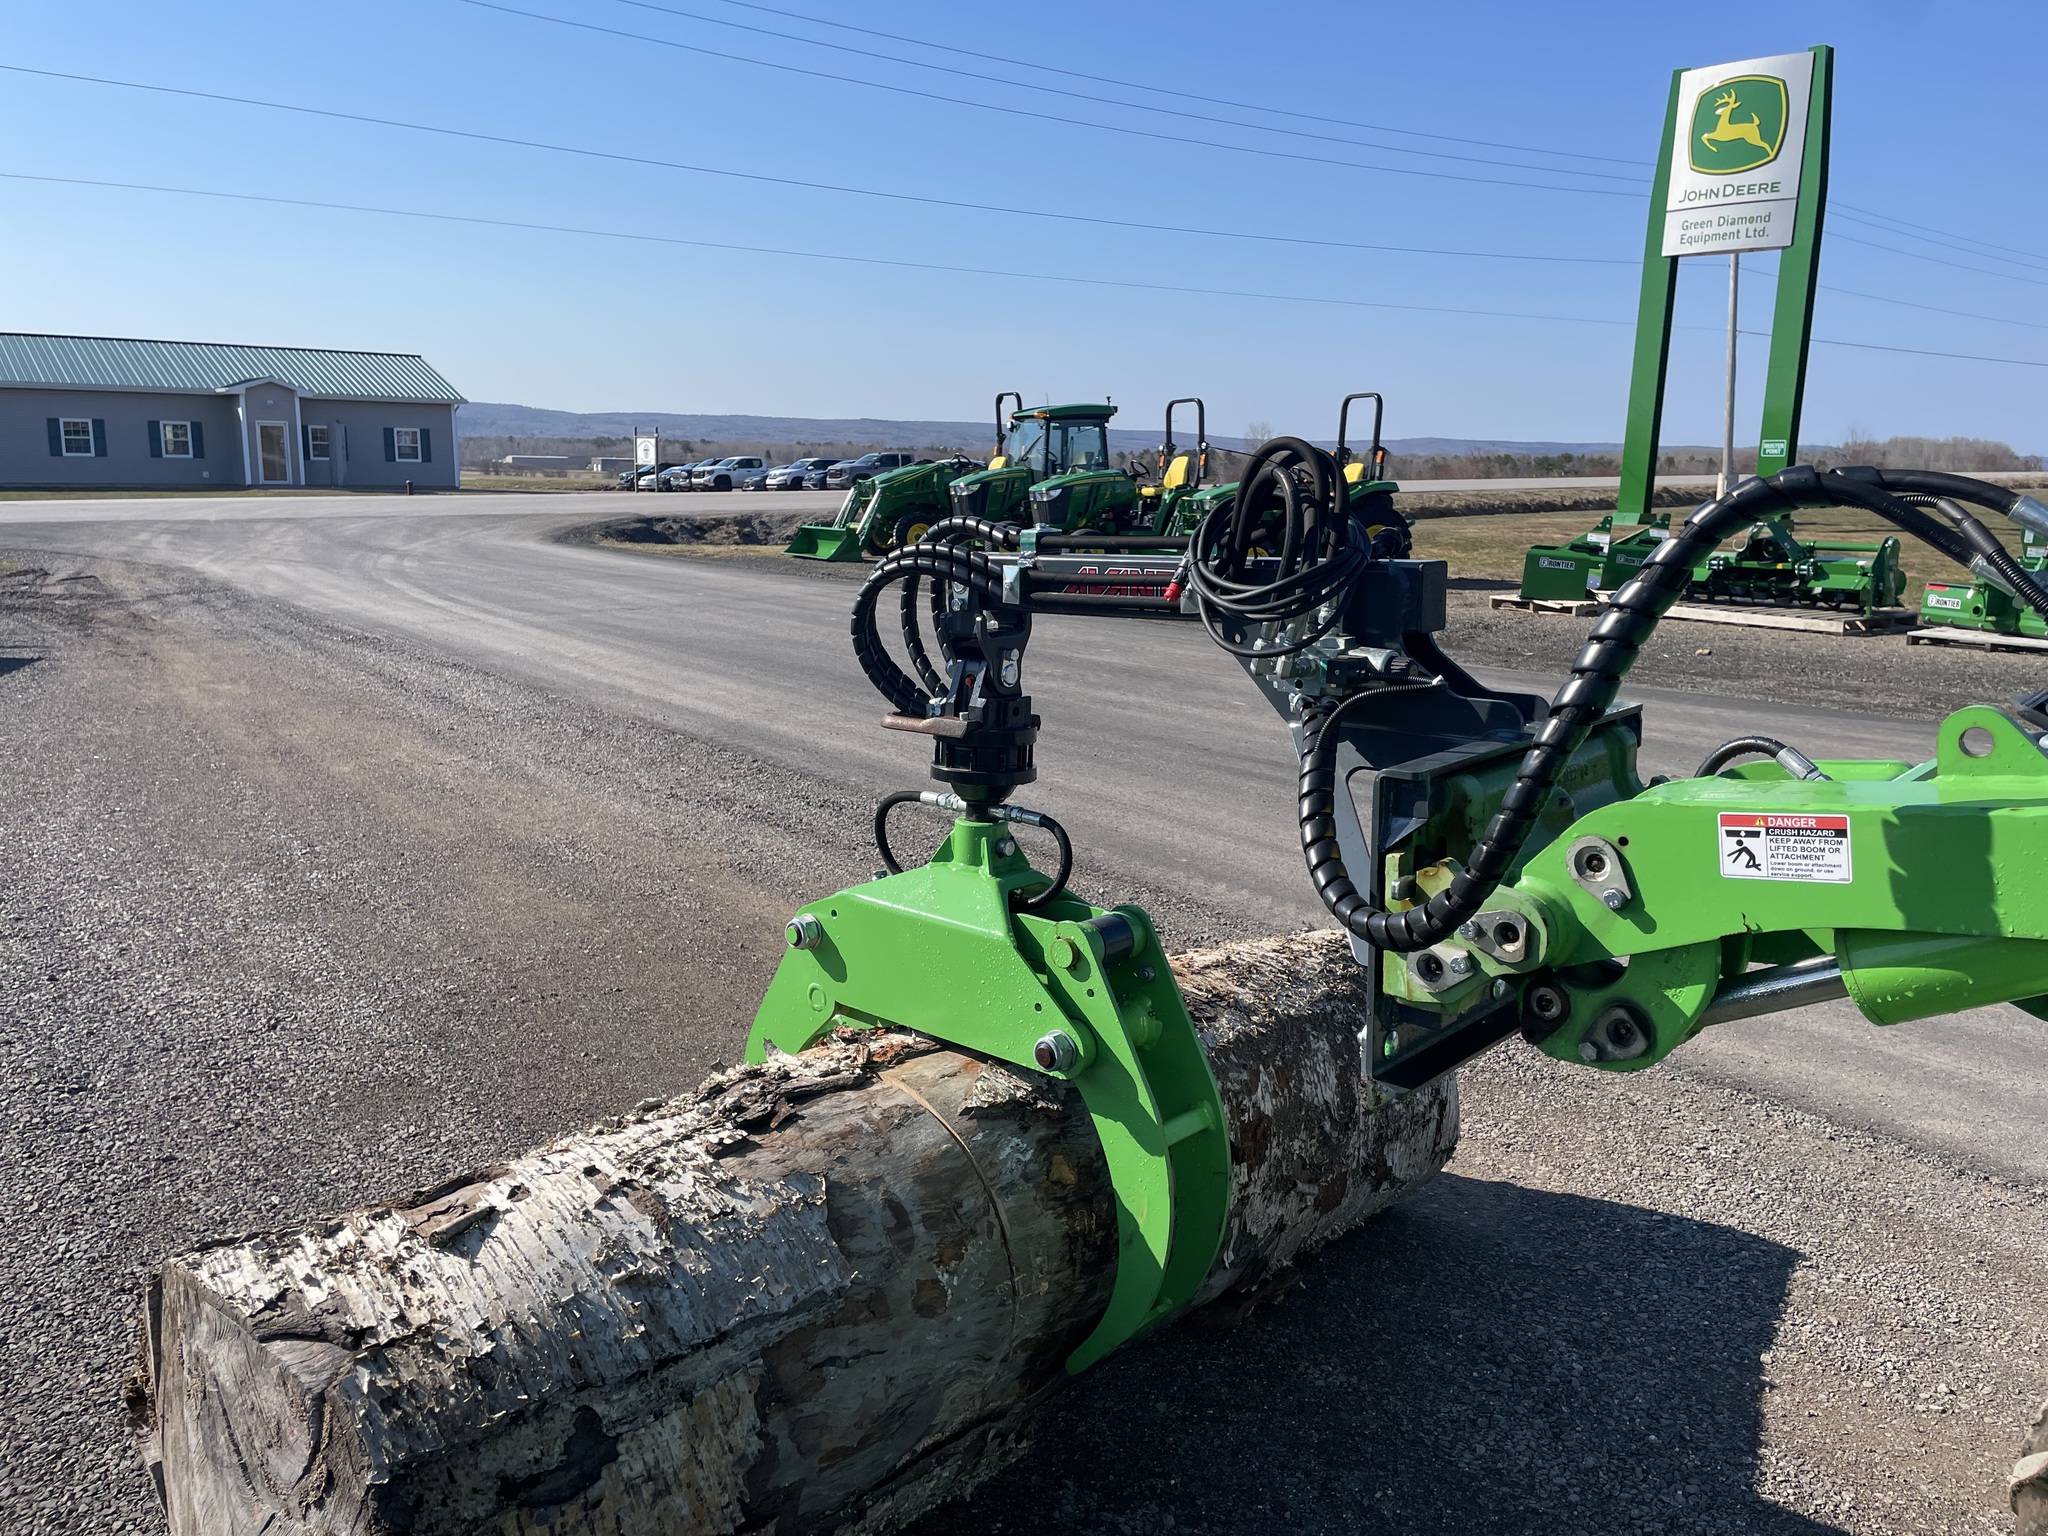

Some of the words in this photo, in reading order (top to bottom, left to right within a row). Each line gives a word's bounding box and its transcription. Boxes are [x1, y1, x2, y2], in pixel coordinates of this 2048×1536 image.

[1678, 187, 1719, 203] JOHN
[1722, 181, 1781, 197] DEERE
[1681, 217, 1712, 231] Green
[1717, 212, 1771, 227] Diamond
[1680, 230, 1740, 246] Equipment
[1745, 227, 1769, 238] Ltd.
[1768, 817, 1816, 827] DANGER
[1770, 853, 1825, 861] ATTACHMENT
